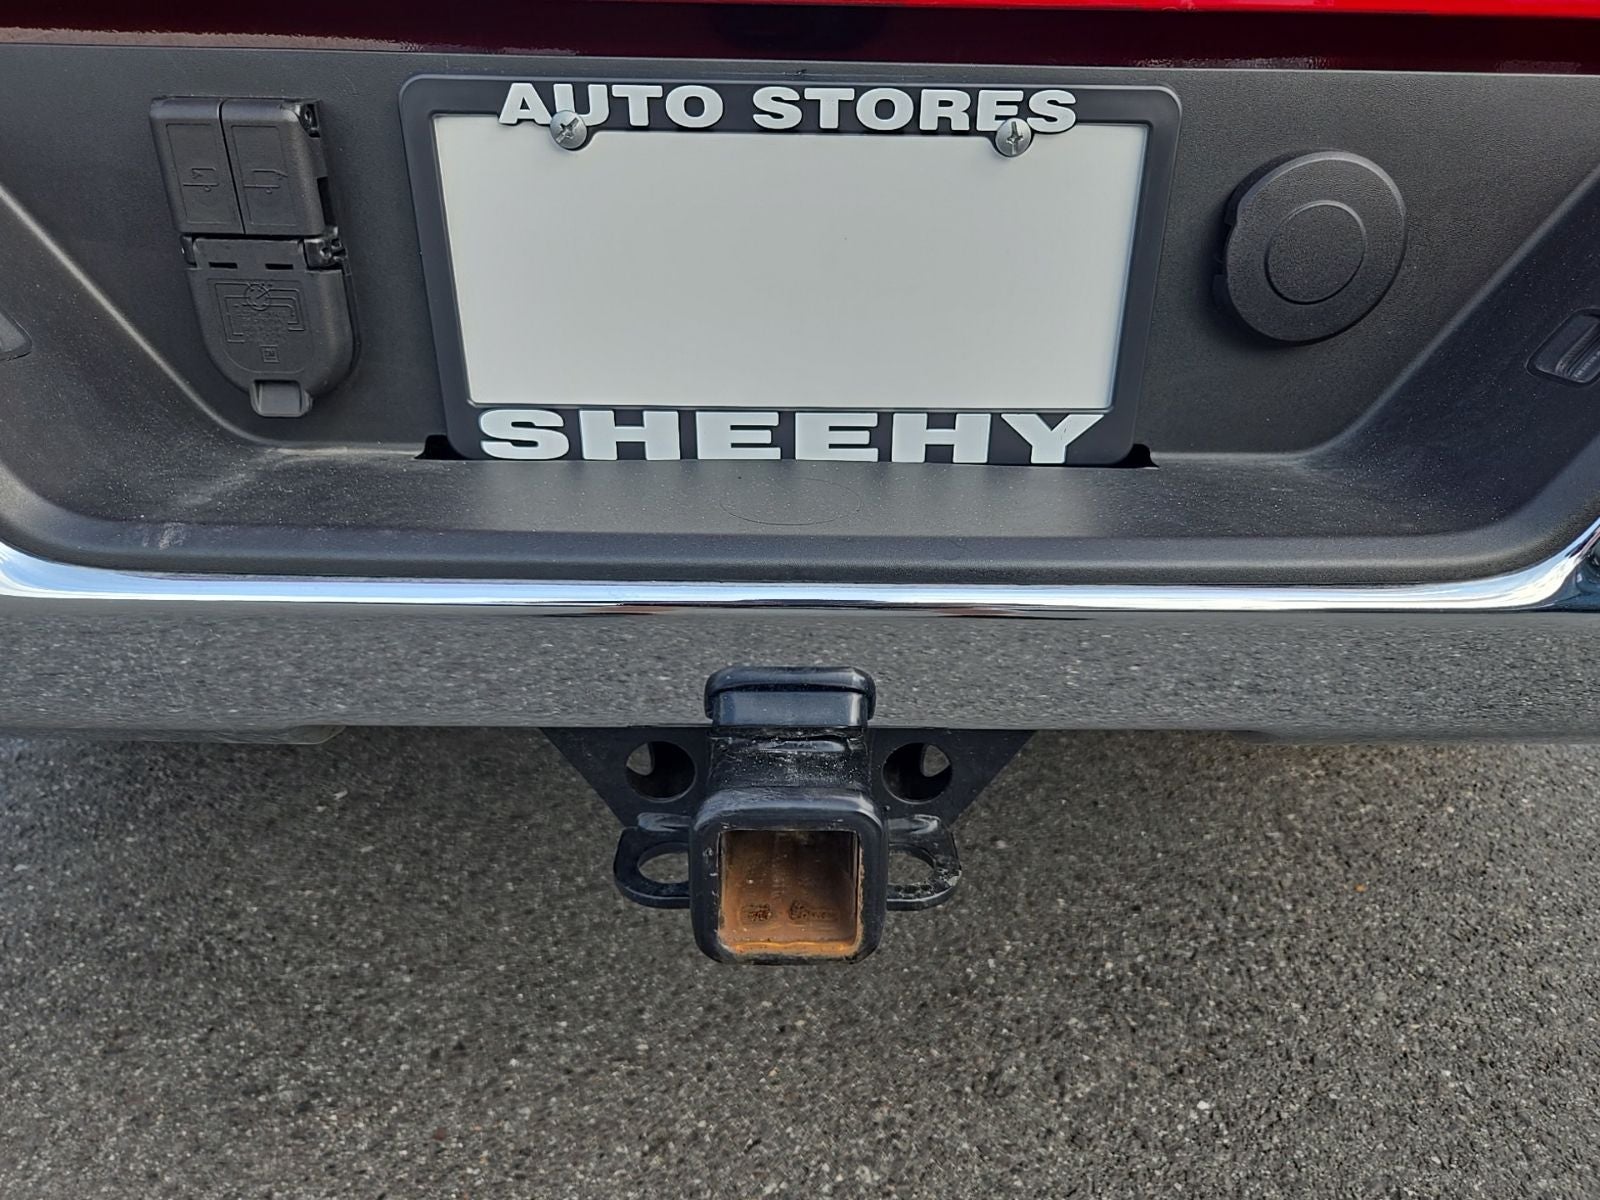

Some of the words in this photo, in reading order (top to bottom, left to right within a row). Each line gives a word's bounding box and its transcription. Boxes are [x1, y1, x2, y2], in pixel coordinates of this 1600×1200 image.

[498, 82, 724, 128] AUTO
[752, 86, 1077, 133] STORES
[479, 408, 1105, 464] SHEEHY
